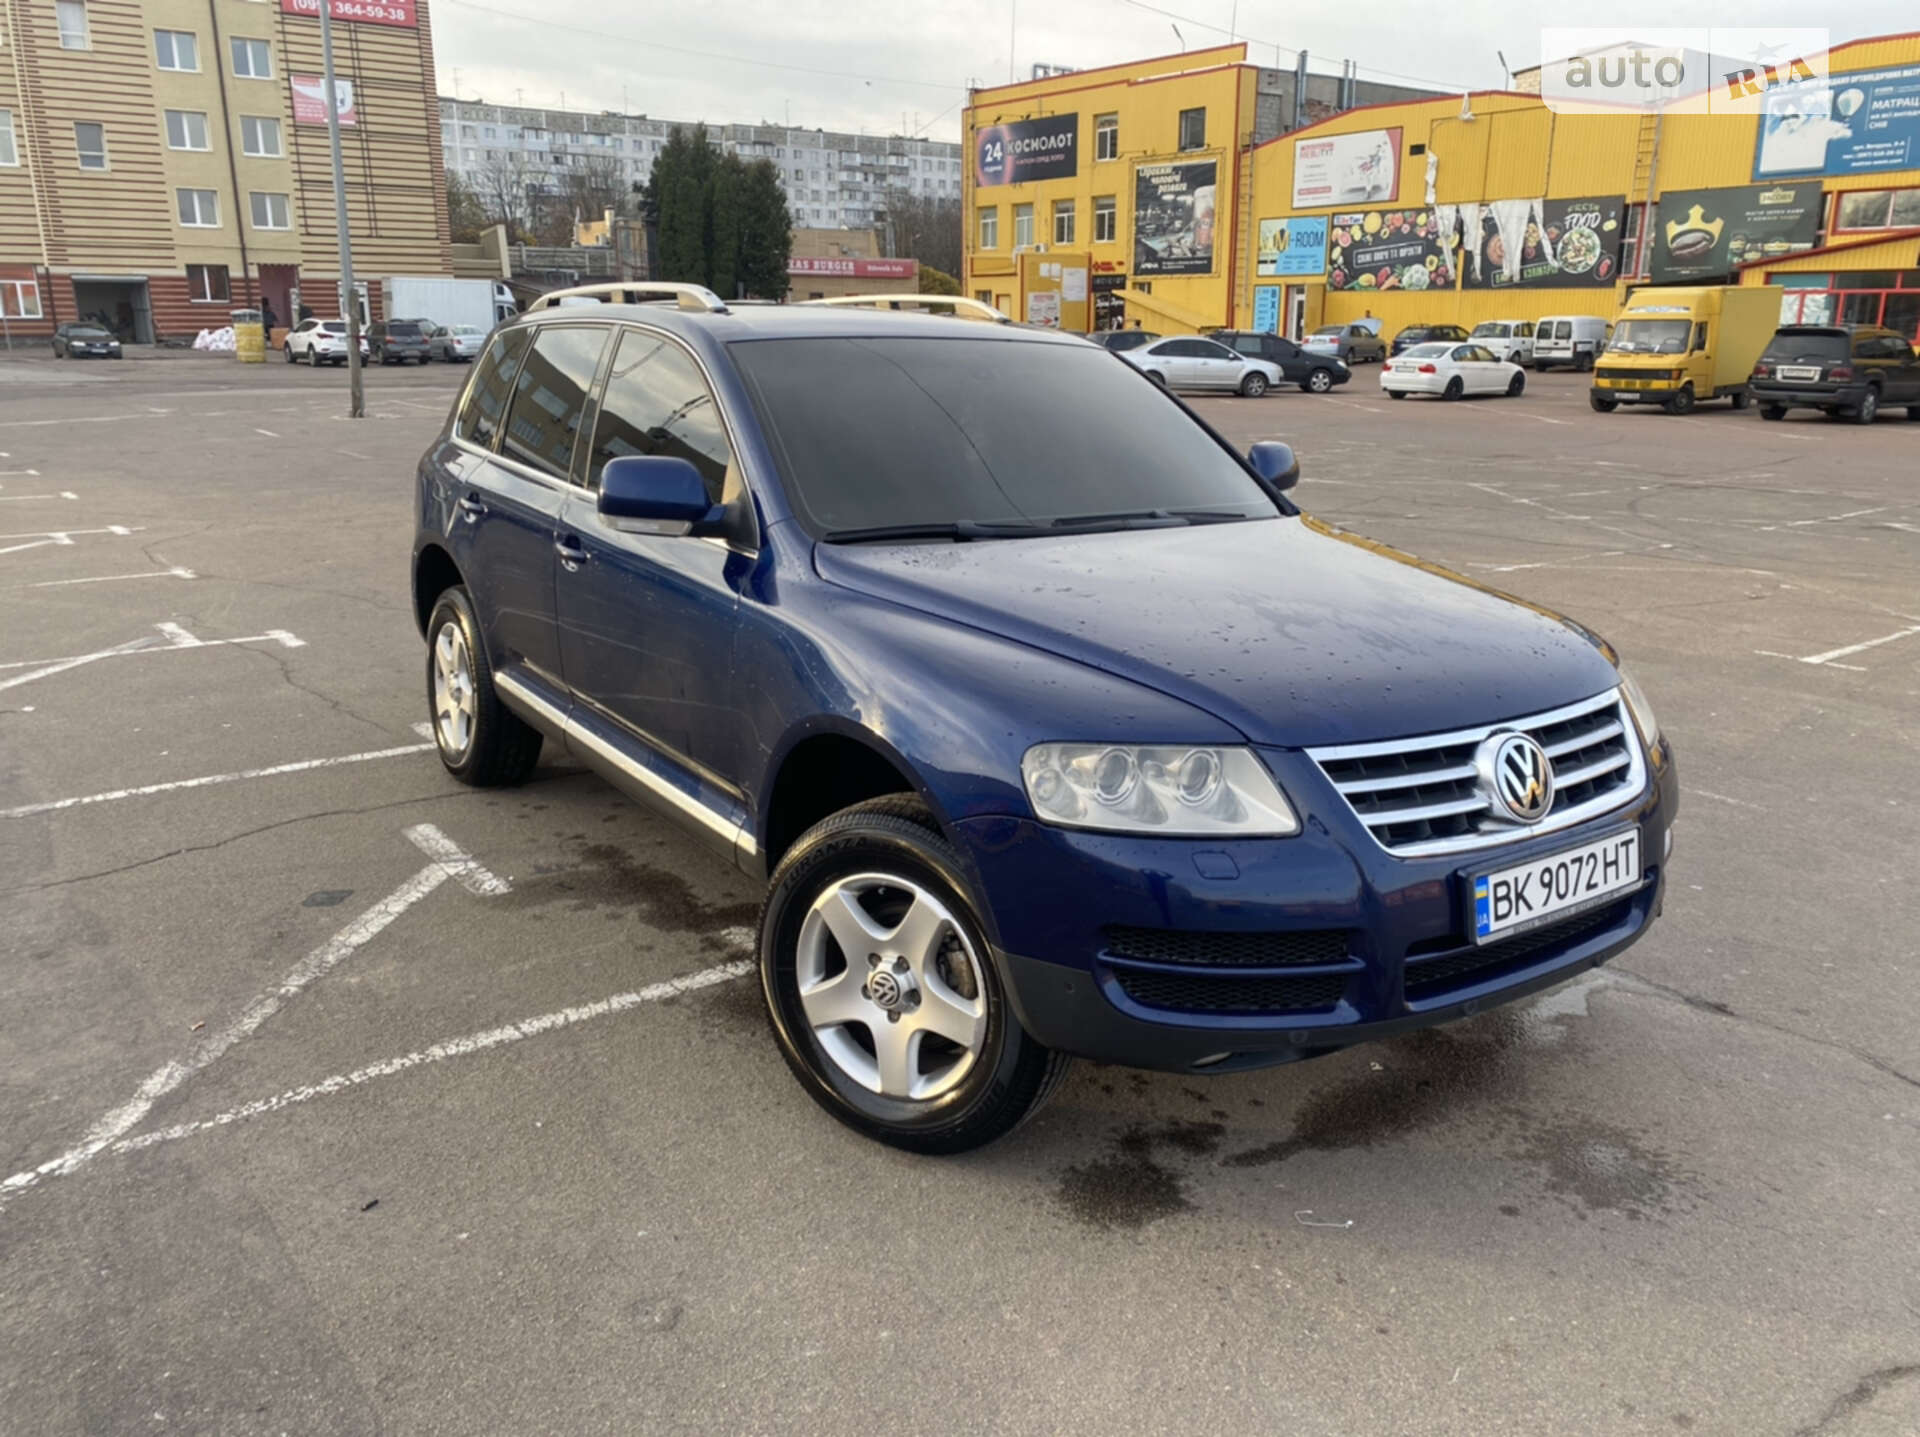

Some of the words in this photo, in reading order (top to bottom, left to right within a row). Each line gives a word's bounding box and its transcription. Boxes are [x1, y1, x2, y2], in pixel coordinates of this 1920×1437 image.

[335, 2, 406, 21] 364-59-38
[984, 142, 1002, 162] 24
[1564, 212, 1601, 229] FOOD
[1493, 872, 1533, 922] BK
[1540, 852, 1598, 907] 9072
[1603, 838, 1635, 885] HT
